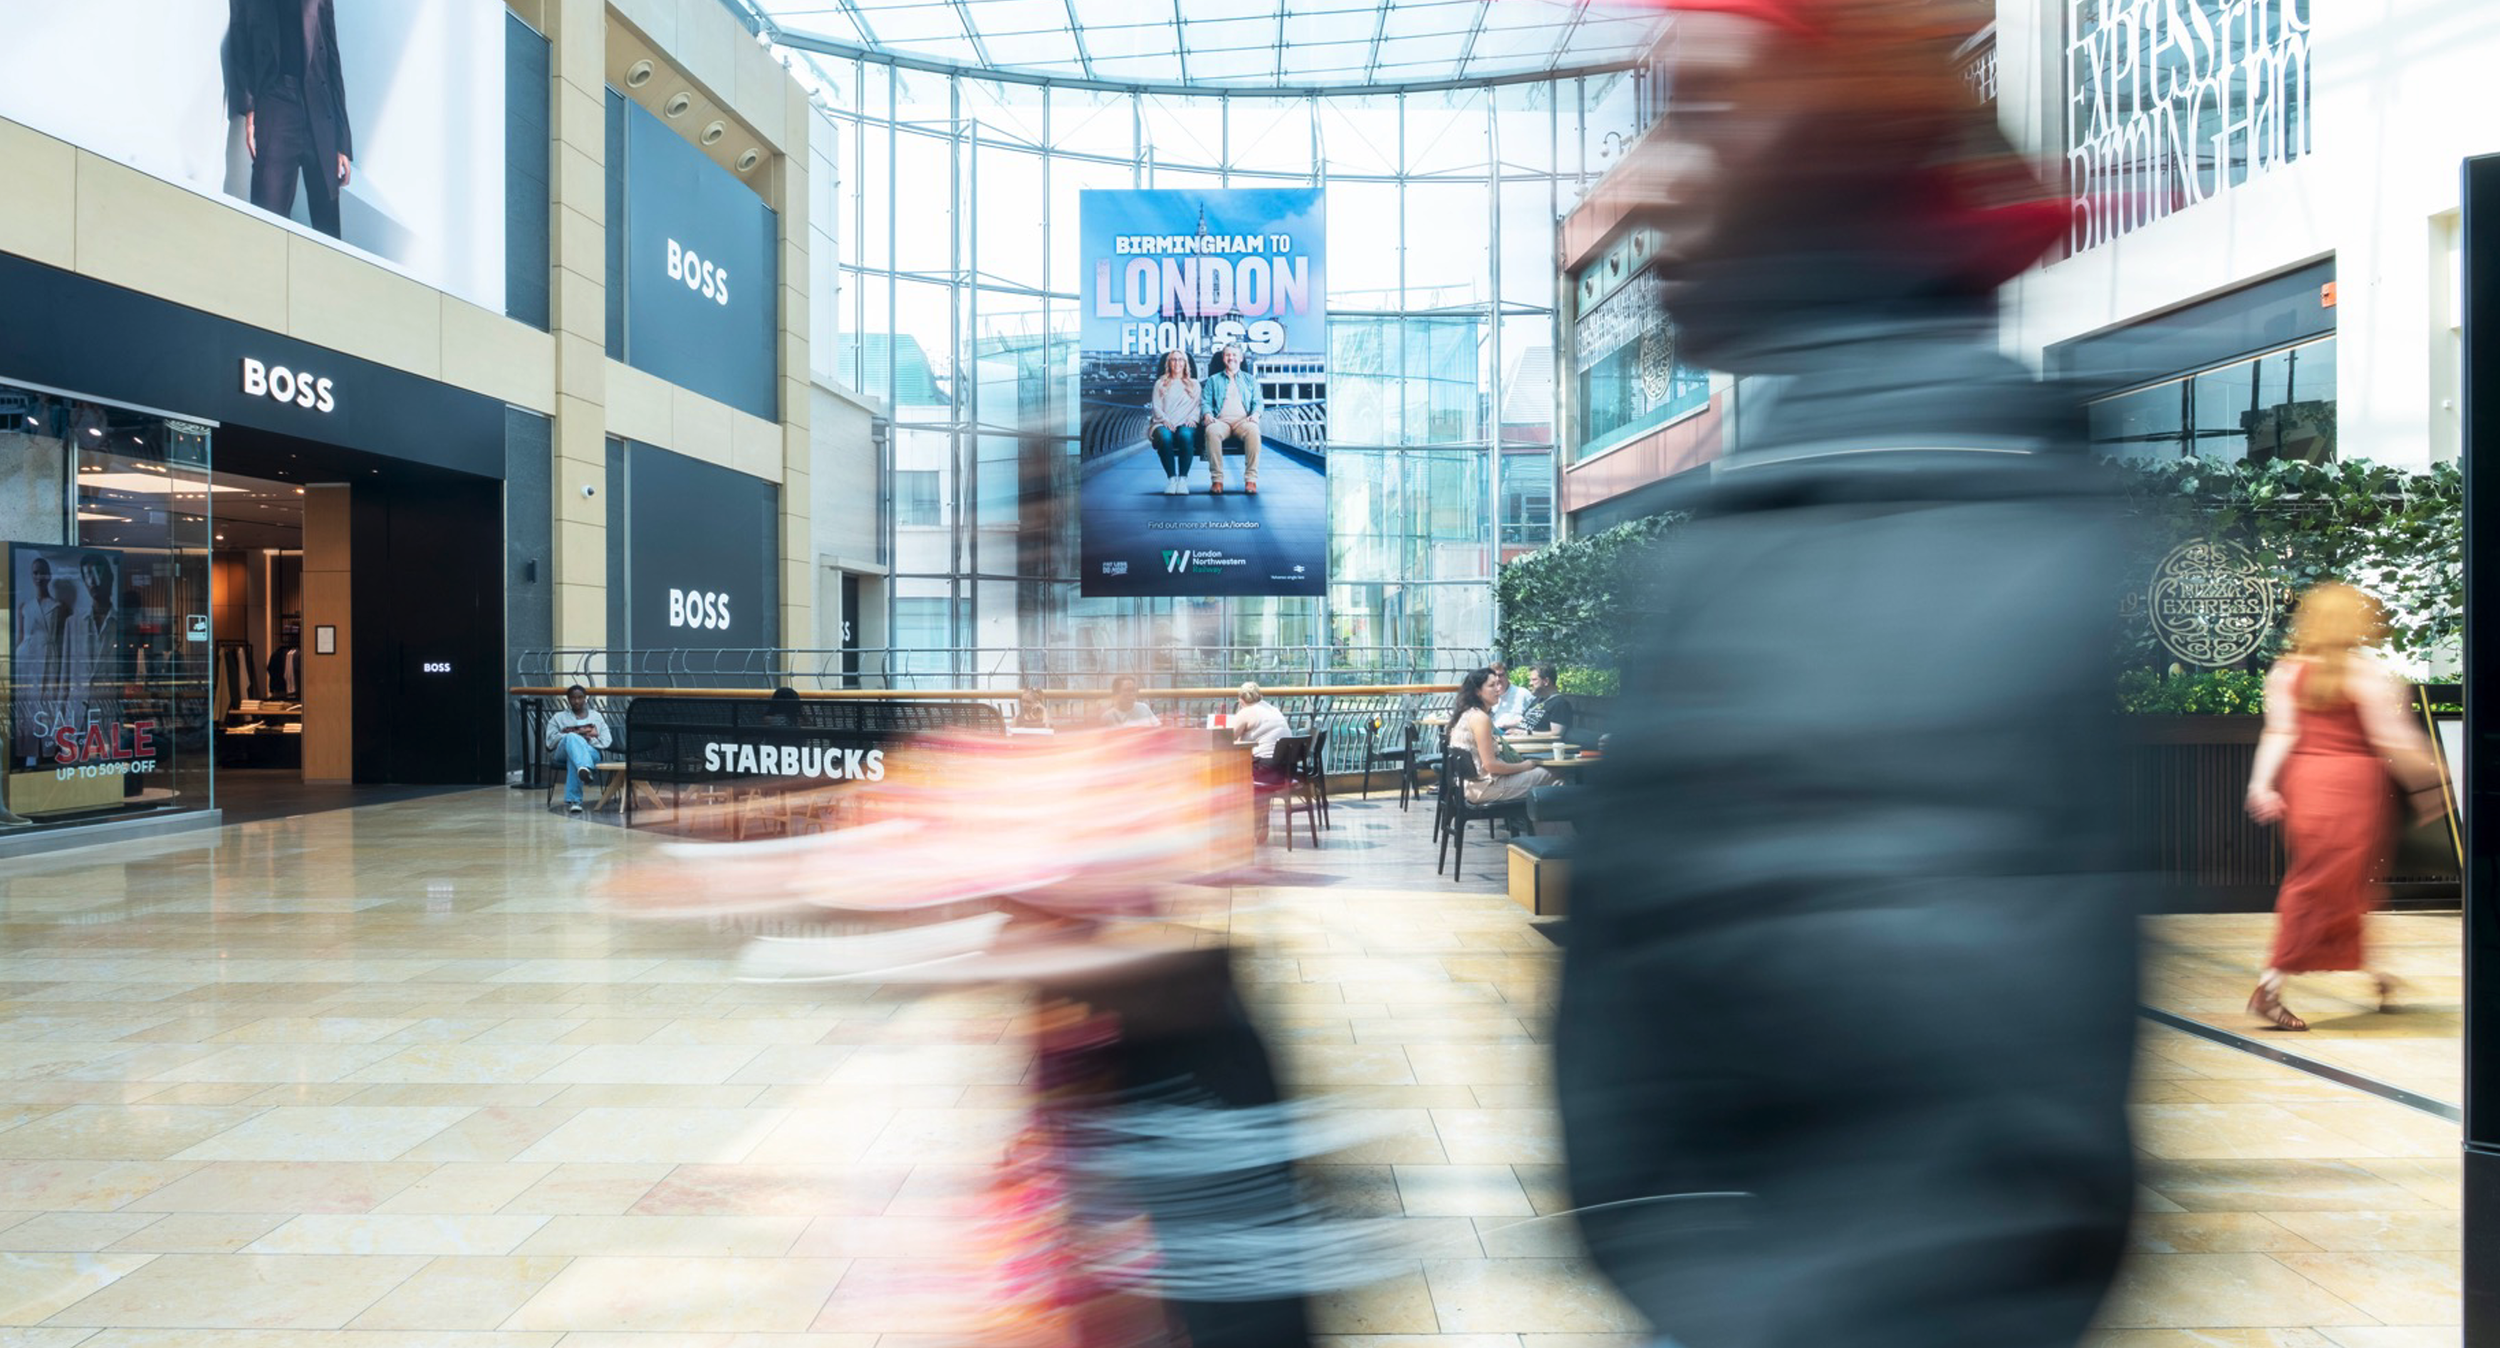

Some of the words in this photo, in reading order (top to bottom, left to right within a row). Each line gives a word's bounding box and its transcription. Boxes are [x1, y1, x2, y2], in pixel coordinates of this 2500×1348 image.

[1115, 235, 1264, 254] BIRMINGHAM
[1269, 234, 1291, 253] TO
[667, 237, 729, 306] BOSS
[1095, 256, 1309, 318] LONDON
[1121, 322, 1201, 355] FROM
[1211, 320, 1285, 354] £9
[242, 356, 335, 413] BOSS
[1147, 520, 1164, 529] Find
[1165, 521, 1178, 529] out
[1199, 521, 1208, 529] at
[1192, 550, 1222, 558] London
[1192, 557, 1246, 566] Northwestern
[2180, 581, 2242, 598] PIZZA
[669, 588, 731, 631] BOSS
[2162, 599, 2260, 614] EXPRESS
[423, 662, 451, 673] BOSS
[55, 720, 156, 764] SALE
[56, 767, 75, 781] UP
[77, 765, 97, 779] TO
[99, 761, 130, 776] 50%
[130, 760, 156, 773] OFF
[704, 742, 885, 782] STARBUCKS
